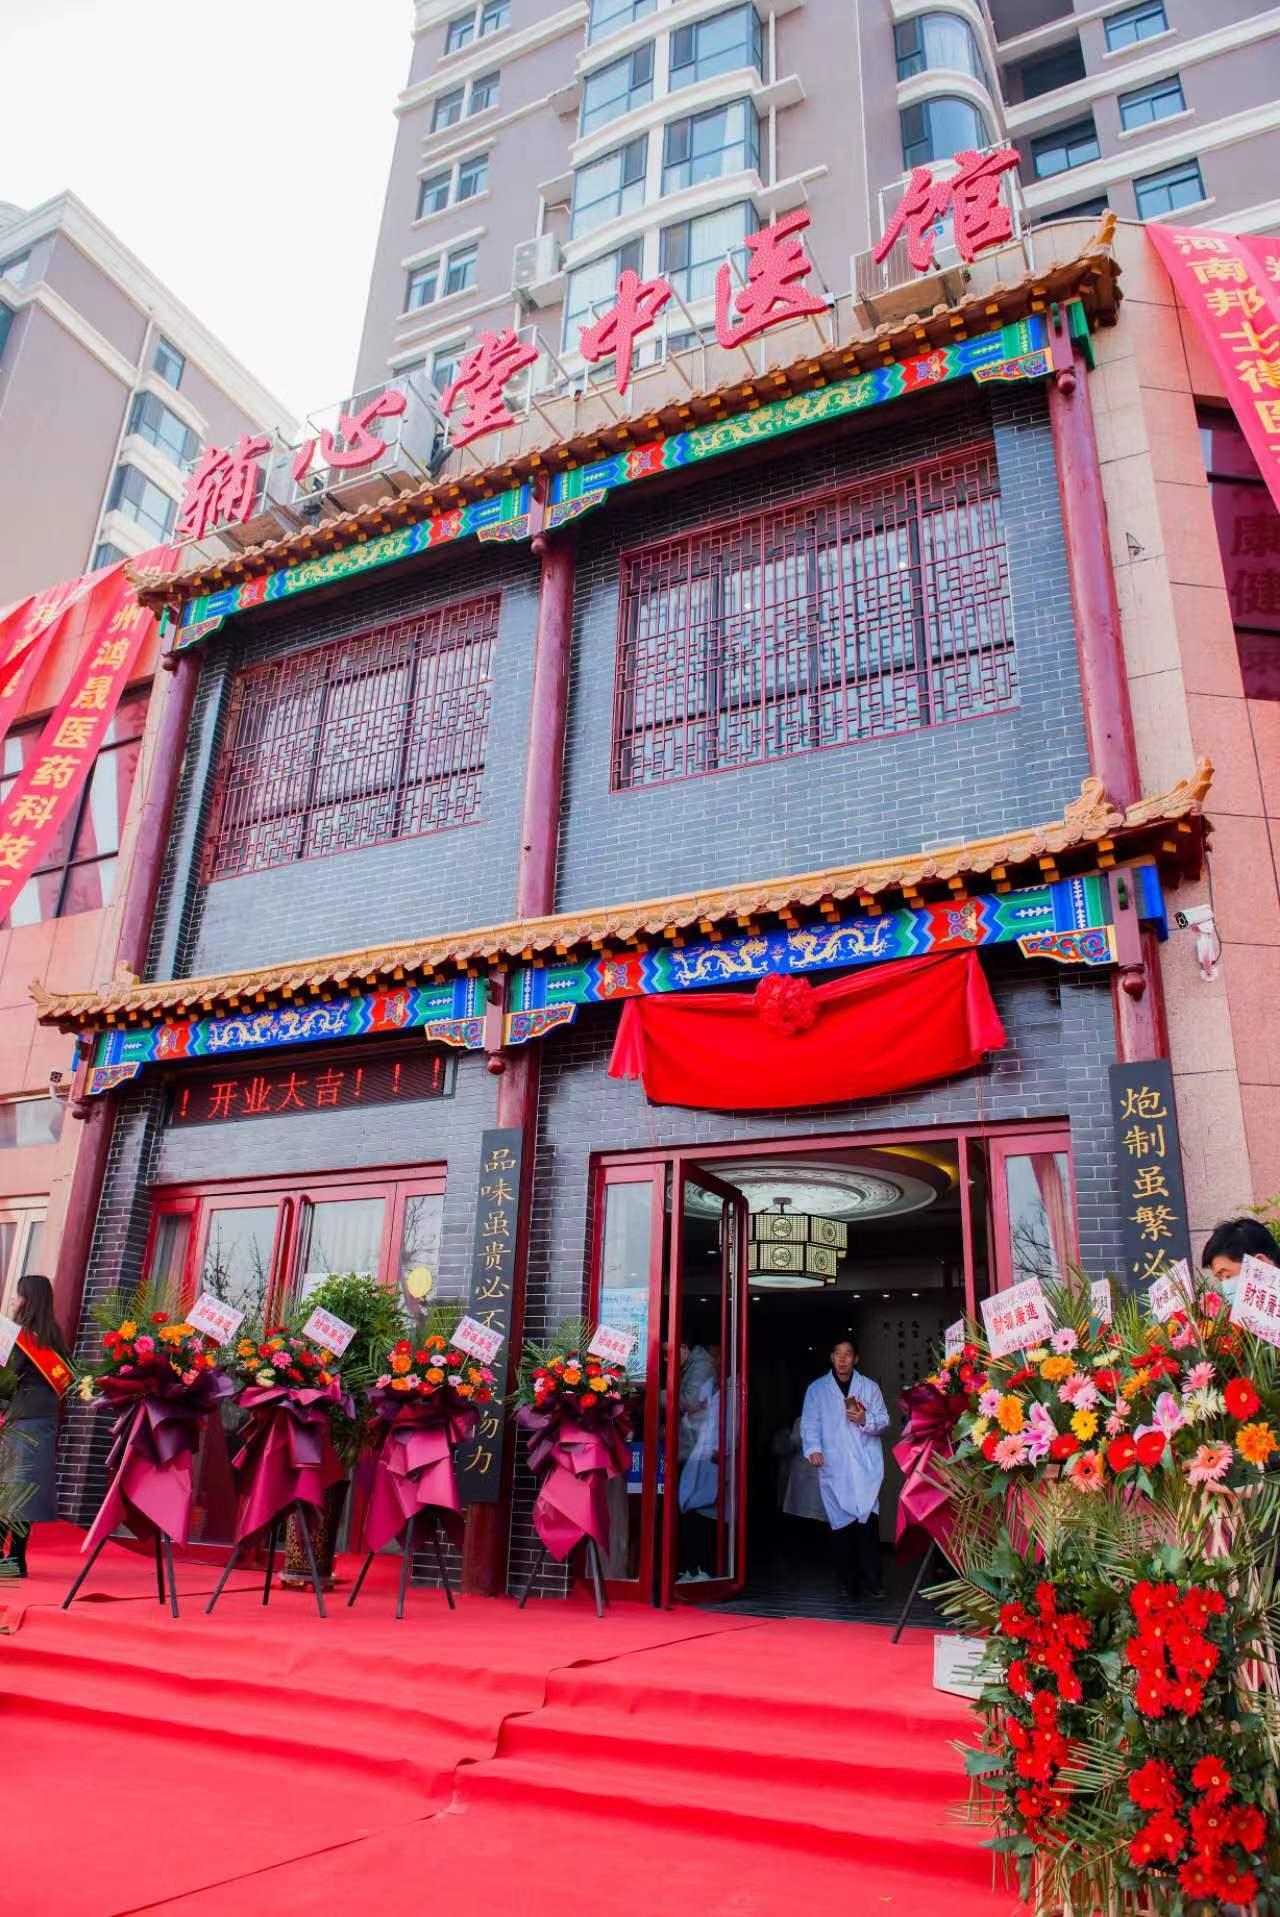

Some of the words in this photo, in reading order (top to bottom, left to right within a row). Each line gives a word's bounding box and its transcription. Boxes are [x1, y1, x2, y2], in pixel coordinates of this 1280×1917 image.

[0, 566, 161, 893] 州鸿晟医药科技
[463, 1147, 517, 1474] 品味虽贵必不物力
